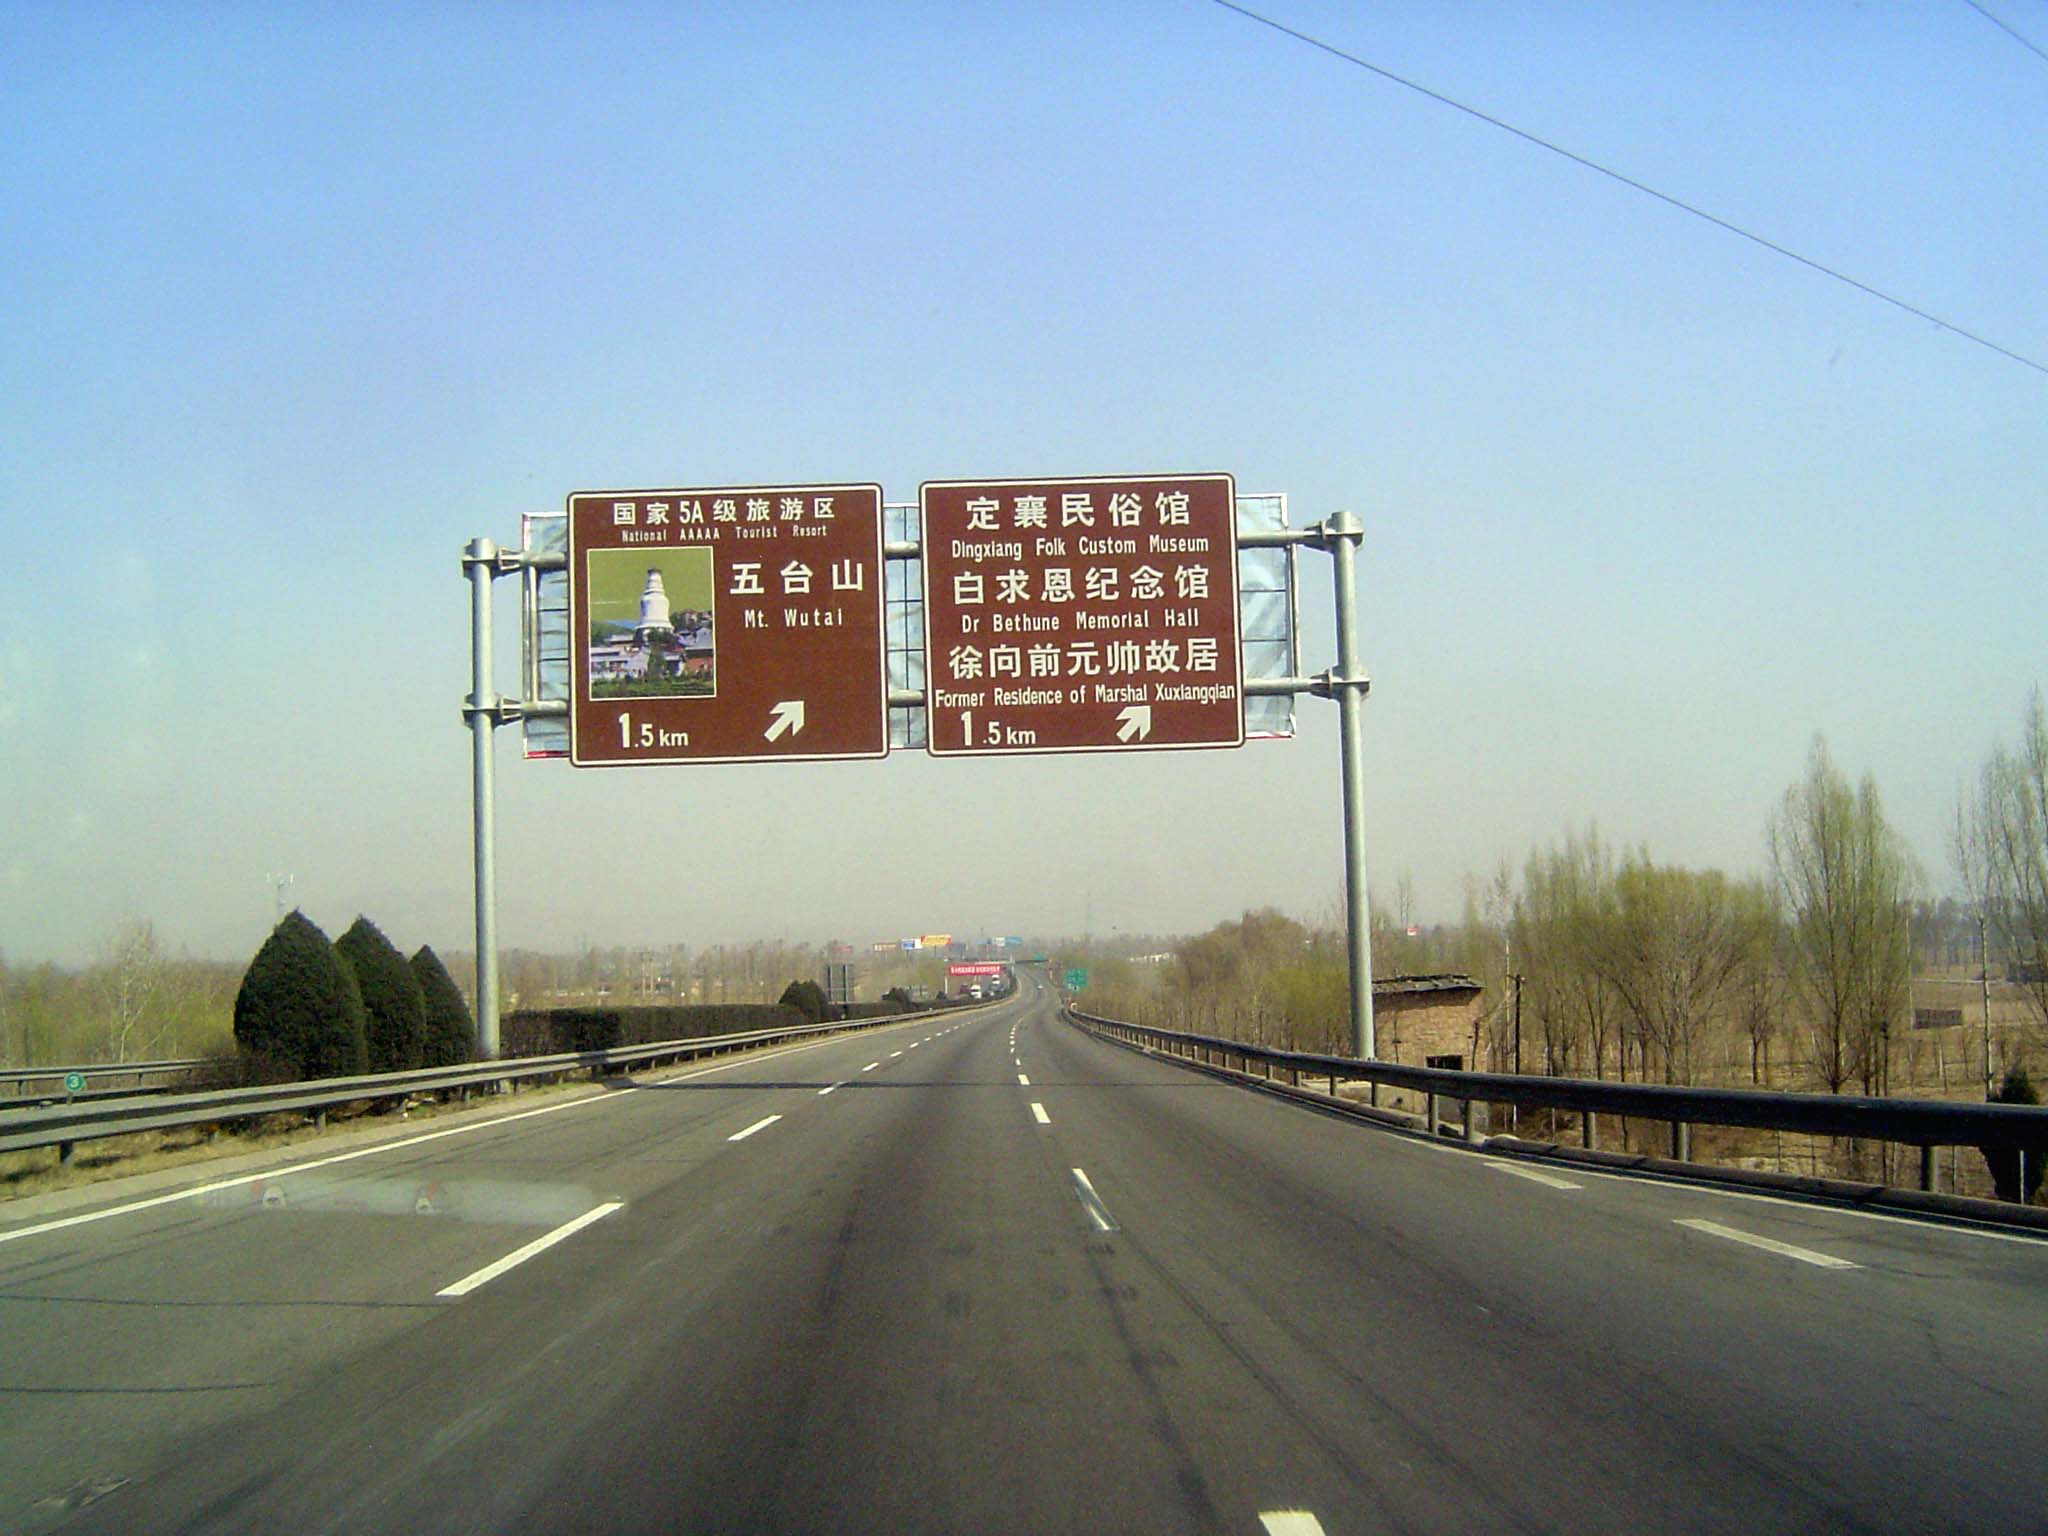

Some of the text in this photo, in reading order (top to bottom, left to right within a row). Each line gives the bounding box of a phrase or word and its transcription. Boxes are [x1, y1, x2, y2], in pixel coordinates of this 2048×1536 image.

[613, 498, 835, 525] 国家5A级旅游区
[966, 490, 1190, 530] 定襄民俗馆
[622, 524, 828, 543] National AAAAA Tourist Resort
[951, 534, 1209, 562] Dingxiang Folk Custom Museum
[729, 559, 863, 594] 五台山
[953, 564, 1209, 605] 白求恩纪念馆
[784, 608, 843, 627] Wutai
[962, 608, 1199, 633] Dr Bethune Memorial Hall
[949, 637, 1219, 680] 徐向前元帅故居
[935, 683, 1235, 708] Former Residence of Marshal Xuxiangqian
[69, 1075, 80, 1088] 3
